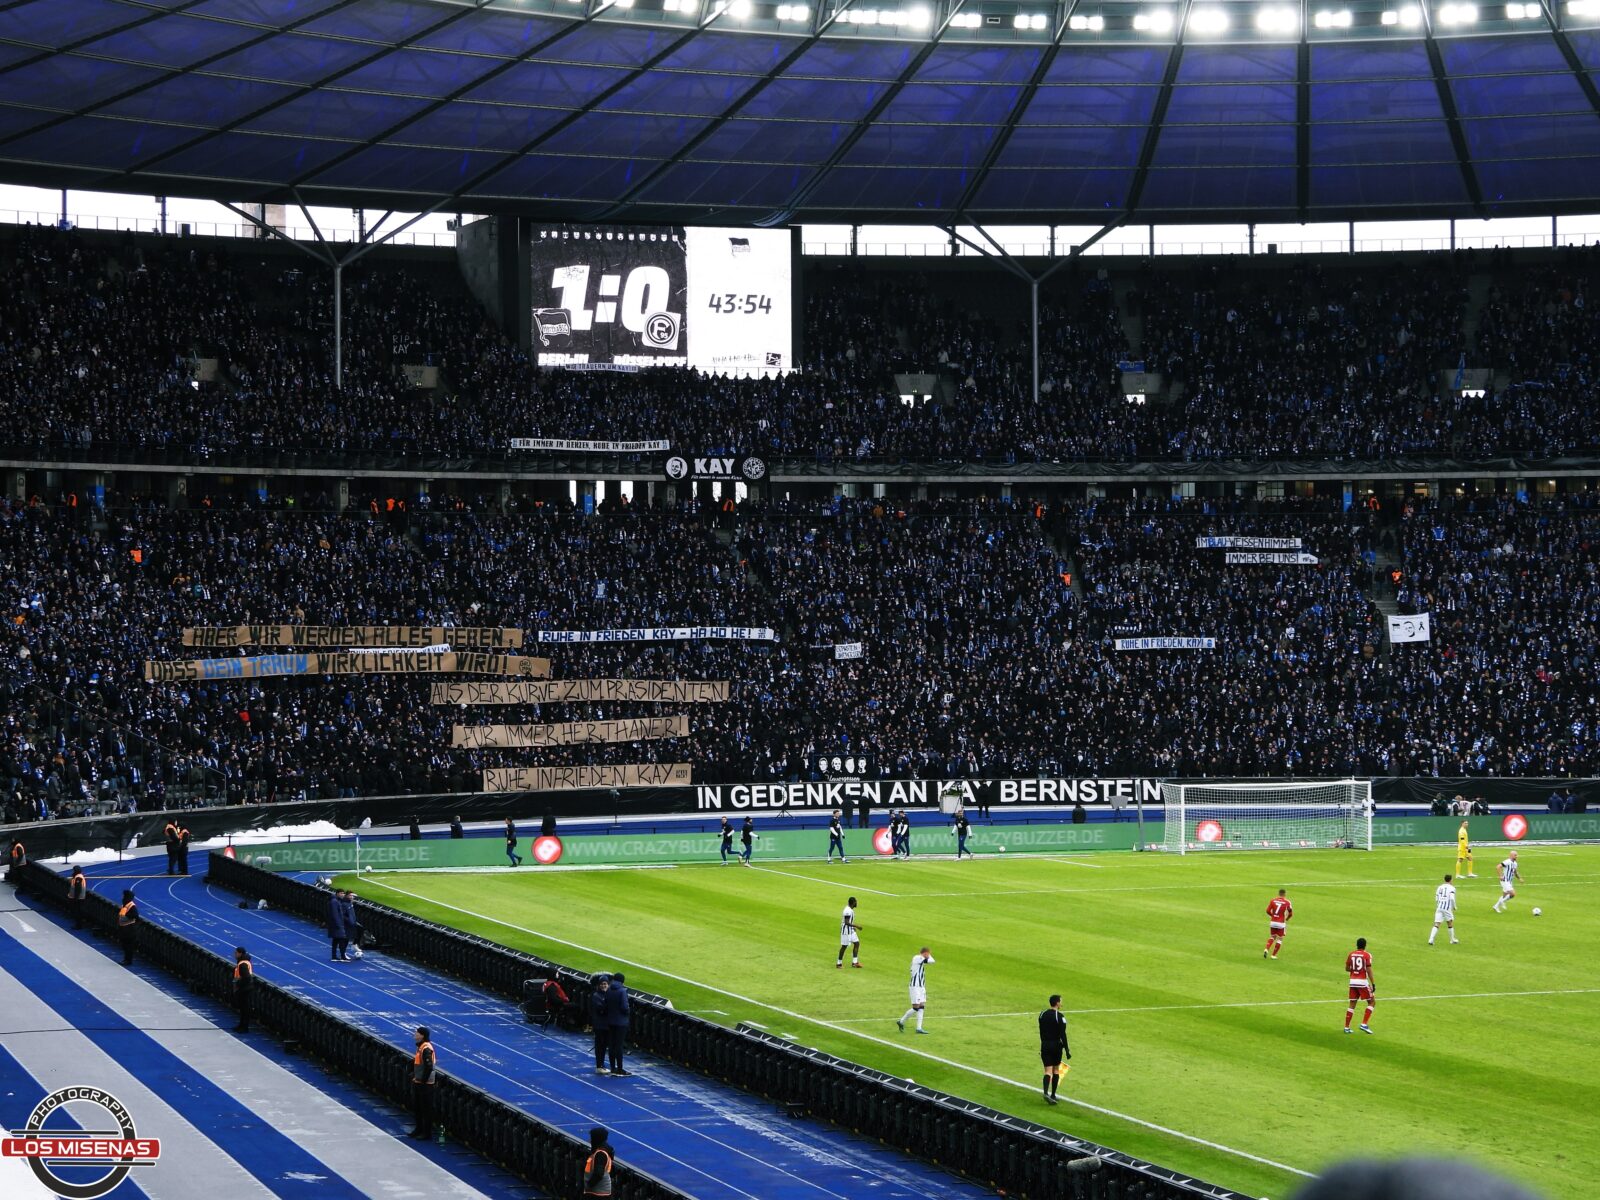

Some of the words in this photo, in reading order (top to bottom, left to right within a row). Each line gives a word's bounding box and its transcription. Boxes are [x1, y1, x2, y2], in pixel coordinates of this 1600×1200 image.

[551, 264, 670, 333] 1:0
[708, 293, 772, 314] 43:54
[392, 344, 409, 355] KAY
[519, 438, 530, 447] FÜR
[533, 439, 553, 448] IMMER
[556, 440, 564, 448] IM
[593, 440, 610, 449] RUHE
[612, 441, 619, 450] IN
[621, 440, 646, 450] FRIEDEN
[648, 440, 660, 449] KAY
[694, 458, 735, 474] KAY
[1265, 538, 1300, 548] HIMMEL
[1228, 553, 1257, 563] IMMER
[193, 626, 238, 646] ABER
[250, 626, 281, 645] WIR
[292, 626, 366, 645] WERDEN
[373, 626, 433, 646] ALLES
[542, 631, 574, 642] RUHE
[580, 631, 591, 641] IN
[596, 629, 645, 641] FRIEDEN
[652, 628, 677, 640] KAY
[690, 627, 706, 638] HA
[710, 627, 725, 638] HO
[731, 627, 751, 639] HE!
[1121, 639, 1139, 649] RUHE
[1141, 639, 1149, 648] IN
[151, 660, 198, 680] DASS
[202, 658, 243, 679] DEIN
[245, 654, 308, 677] TRAUM
[316, 652, 444, 674] WIRKLICHKEIT
[455, 652, 508, 675] WIRD!
[432, 682, 464, 703] AUS
[468, 682, 503, 703] DER
[506, 681, 560, 702] KURVE
[563, 680, 602, 700] ZUM
[606, 680, 724, 701] PRÄSIDENTEN
[505, 724, 559, 746] IMMER
[562, 716, 683, 744] HERTHANER!
[486, 768, 531, 791] RUHE
[536, 768, 553, 789] IN
[637, 763, 674, 785] KAY
[697, 785, 722, 809] IN
[730, 781, 881, 808] GEDENKEN
[888, 780, 928, 803] AN
[1000, 779, 1161, 802] BERNSTEIN
[566, 837, 776, 857] WWW.CRAZYBUZZDE
[909, 829, 1104, 848] WWW.RAZYBUZZER.DE
[1275, 902, 1283, 915] 7
[1351, 956, 1363, 971] 19
